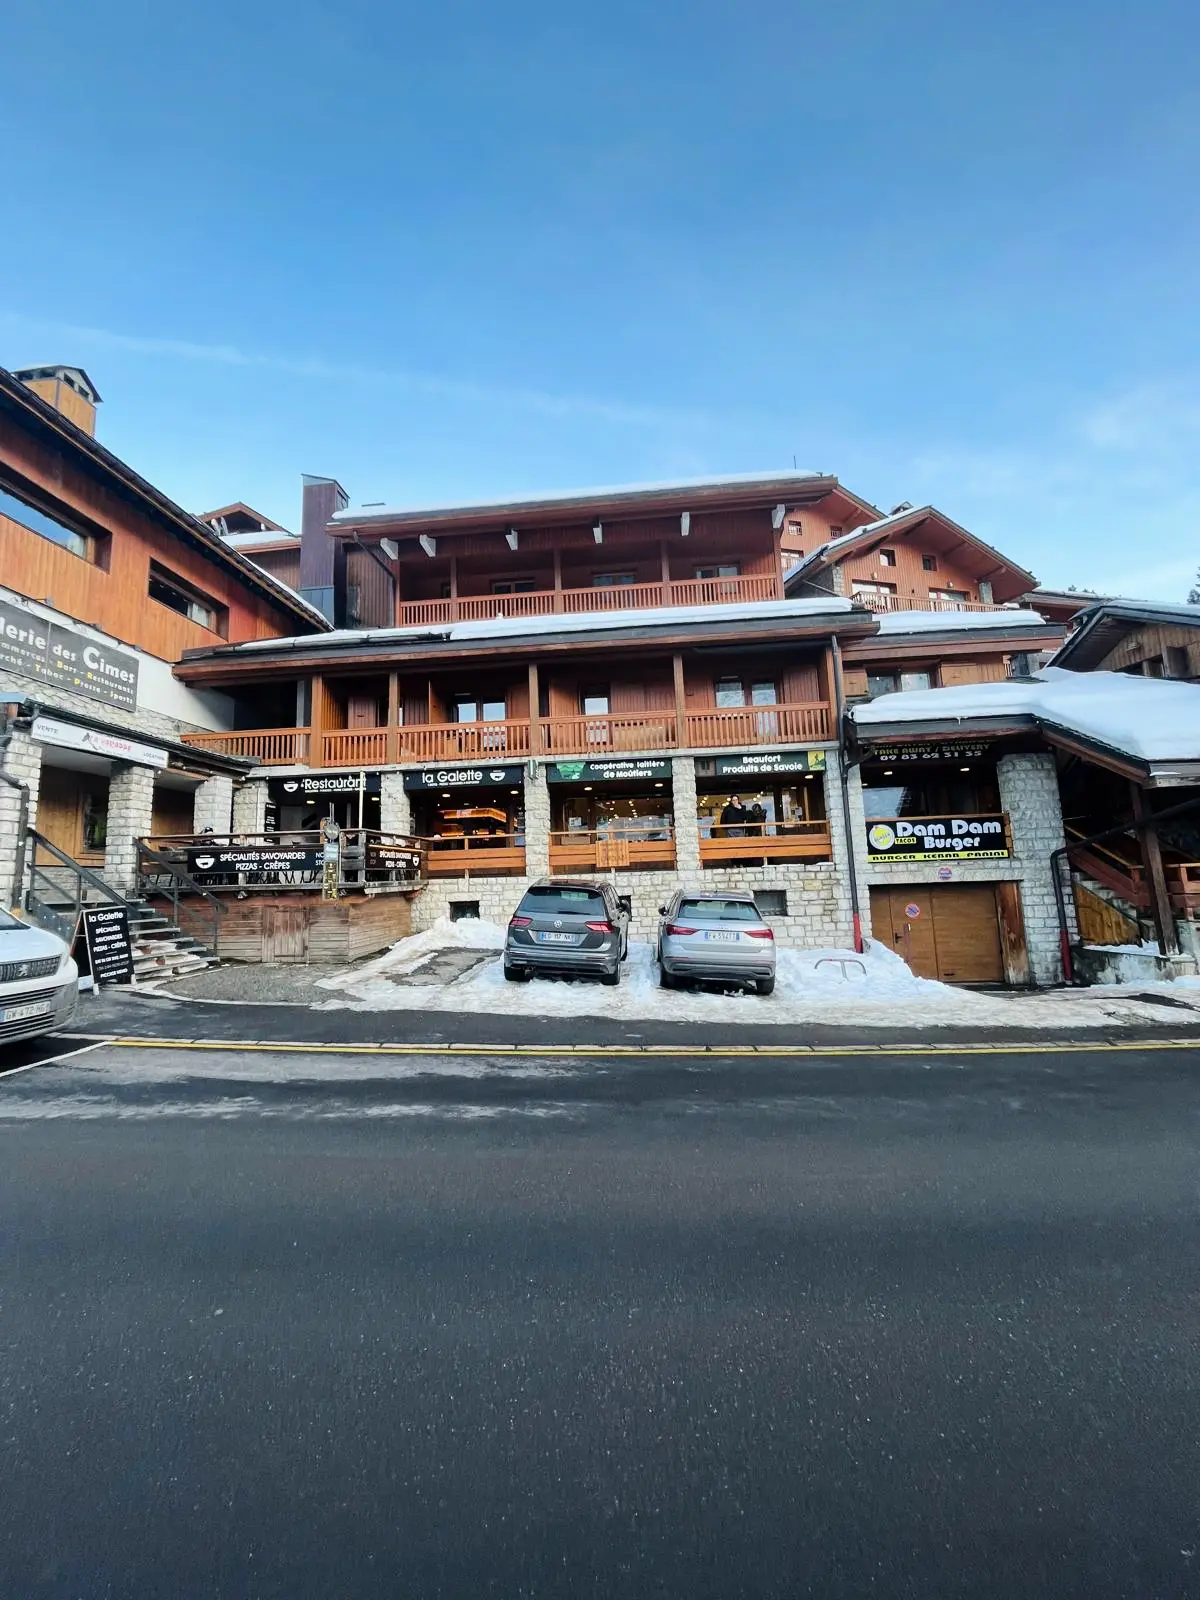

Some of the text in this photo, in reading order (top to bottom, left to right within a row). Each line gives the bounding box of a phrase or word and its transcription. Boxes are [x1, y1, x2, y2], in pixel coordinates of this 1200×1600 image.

[52, 644, 77, 662] des
[83, 646, 136, 684] Cimes
[34, 663, 64, 681] Tabac
[56, 660, 77, 674] Bars
[86, 671, 134, 695] Restaurants
[942, 743, 990, 752] DELIVERY
[742, 754, 782, 764] Beaufort
[590, 760, 665, 771] Coopérative laitière
[722, 763, 759, 774] Produits
[760, 763, 772, 772] de
[773, 762, 803, 772] Savoie
[422, 772, 434, 784] la
[437, 770, 483, 781] Galette
[603, 769, 652, 779] de Moûtiers
[896, 819, 1002, 837] Dam Dam
[924, 836, 980, 851] Burger
[220, 851, 306, 862] SPÉCIALITÉS SAVOYARDES
[235, 861, 290, 871] PIZZAS CRÊPES
[89, 911, 123, 923] la Galette
